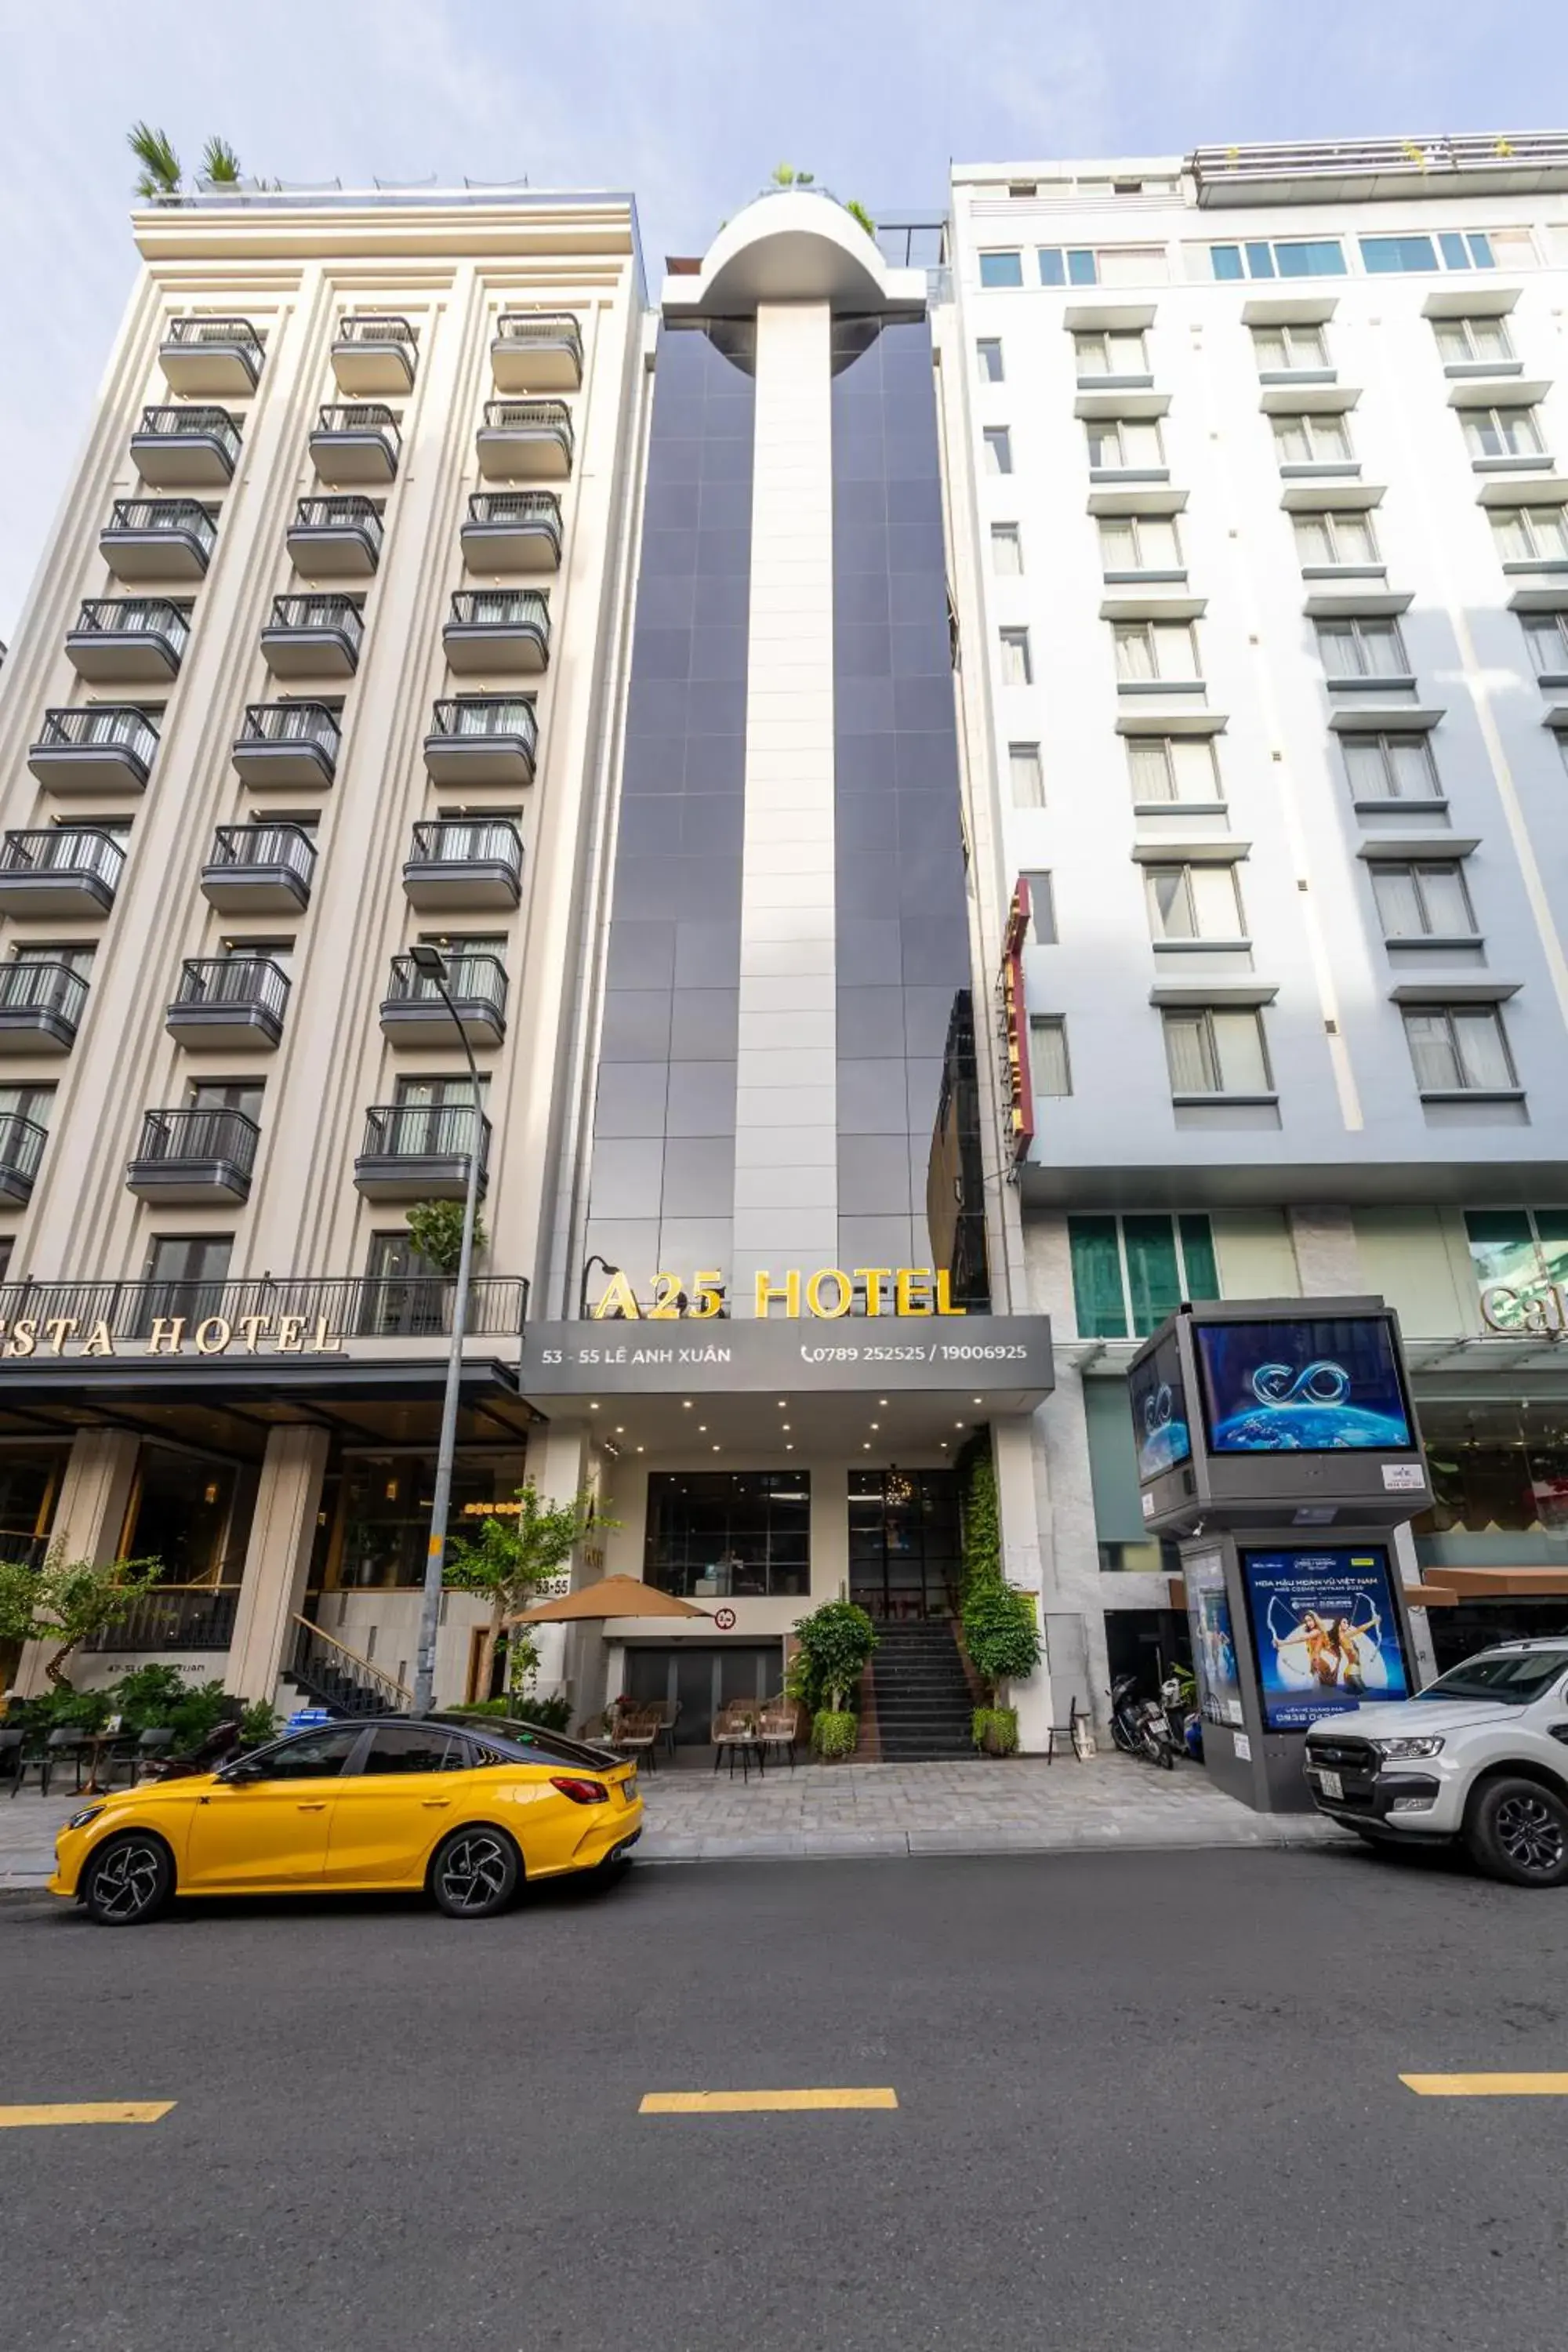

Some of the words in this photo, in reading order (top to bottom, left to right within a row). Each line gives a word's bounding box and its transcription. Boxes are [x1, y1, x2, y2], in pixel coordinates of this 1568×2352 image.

[593, 1271, 722, 1319] A25
[754, 1268, 967, 1319] HOTEL
[1479, 1284, 1568, 1331] Cal
[0, 1319, 115, 1356] STA
[146, 1315, 343, 1355] HOTEL
[541, 1349, 563, 1364] 53
[578, 1348, 600, 1364] 55
[604, 1345, 628, 1364] LÊ
[631, 1348, 673, 1364] ANH
[677, 1344, 732, 1363] XUÂN
[813, 1347, 858, 1361] 0789
[863, 1346, 926, 1361] 252525
[929, 1344, 937, 1362] /
[941, 1345, 1028, 1360] 19006925
